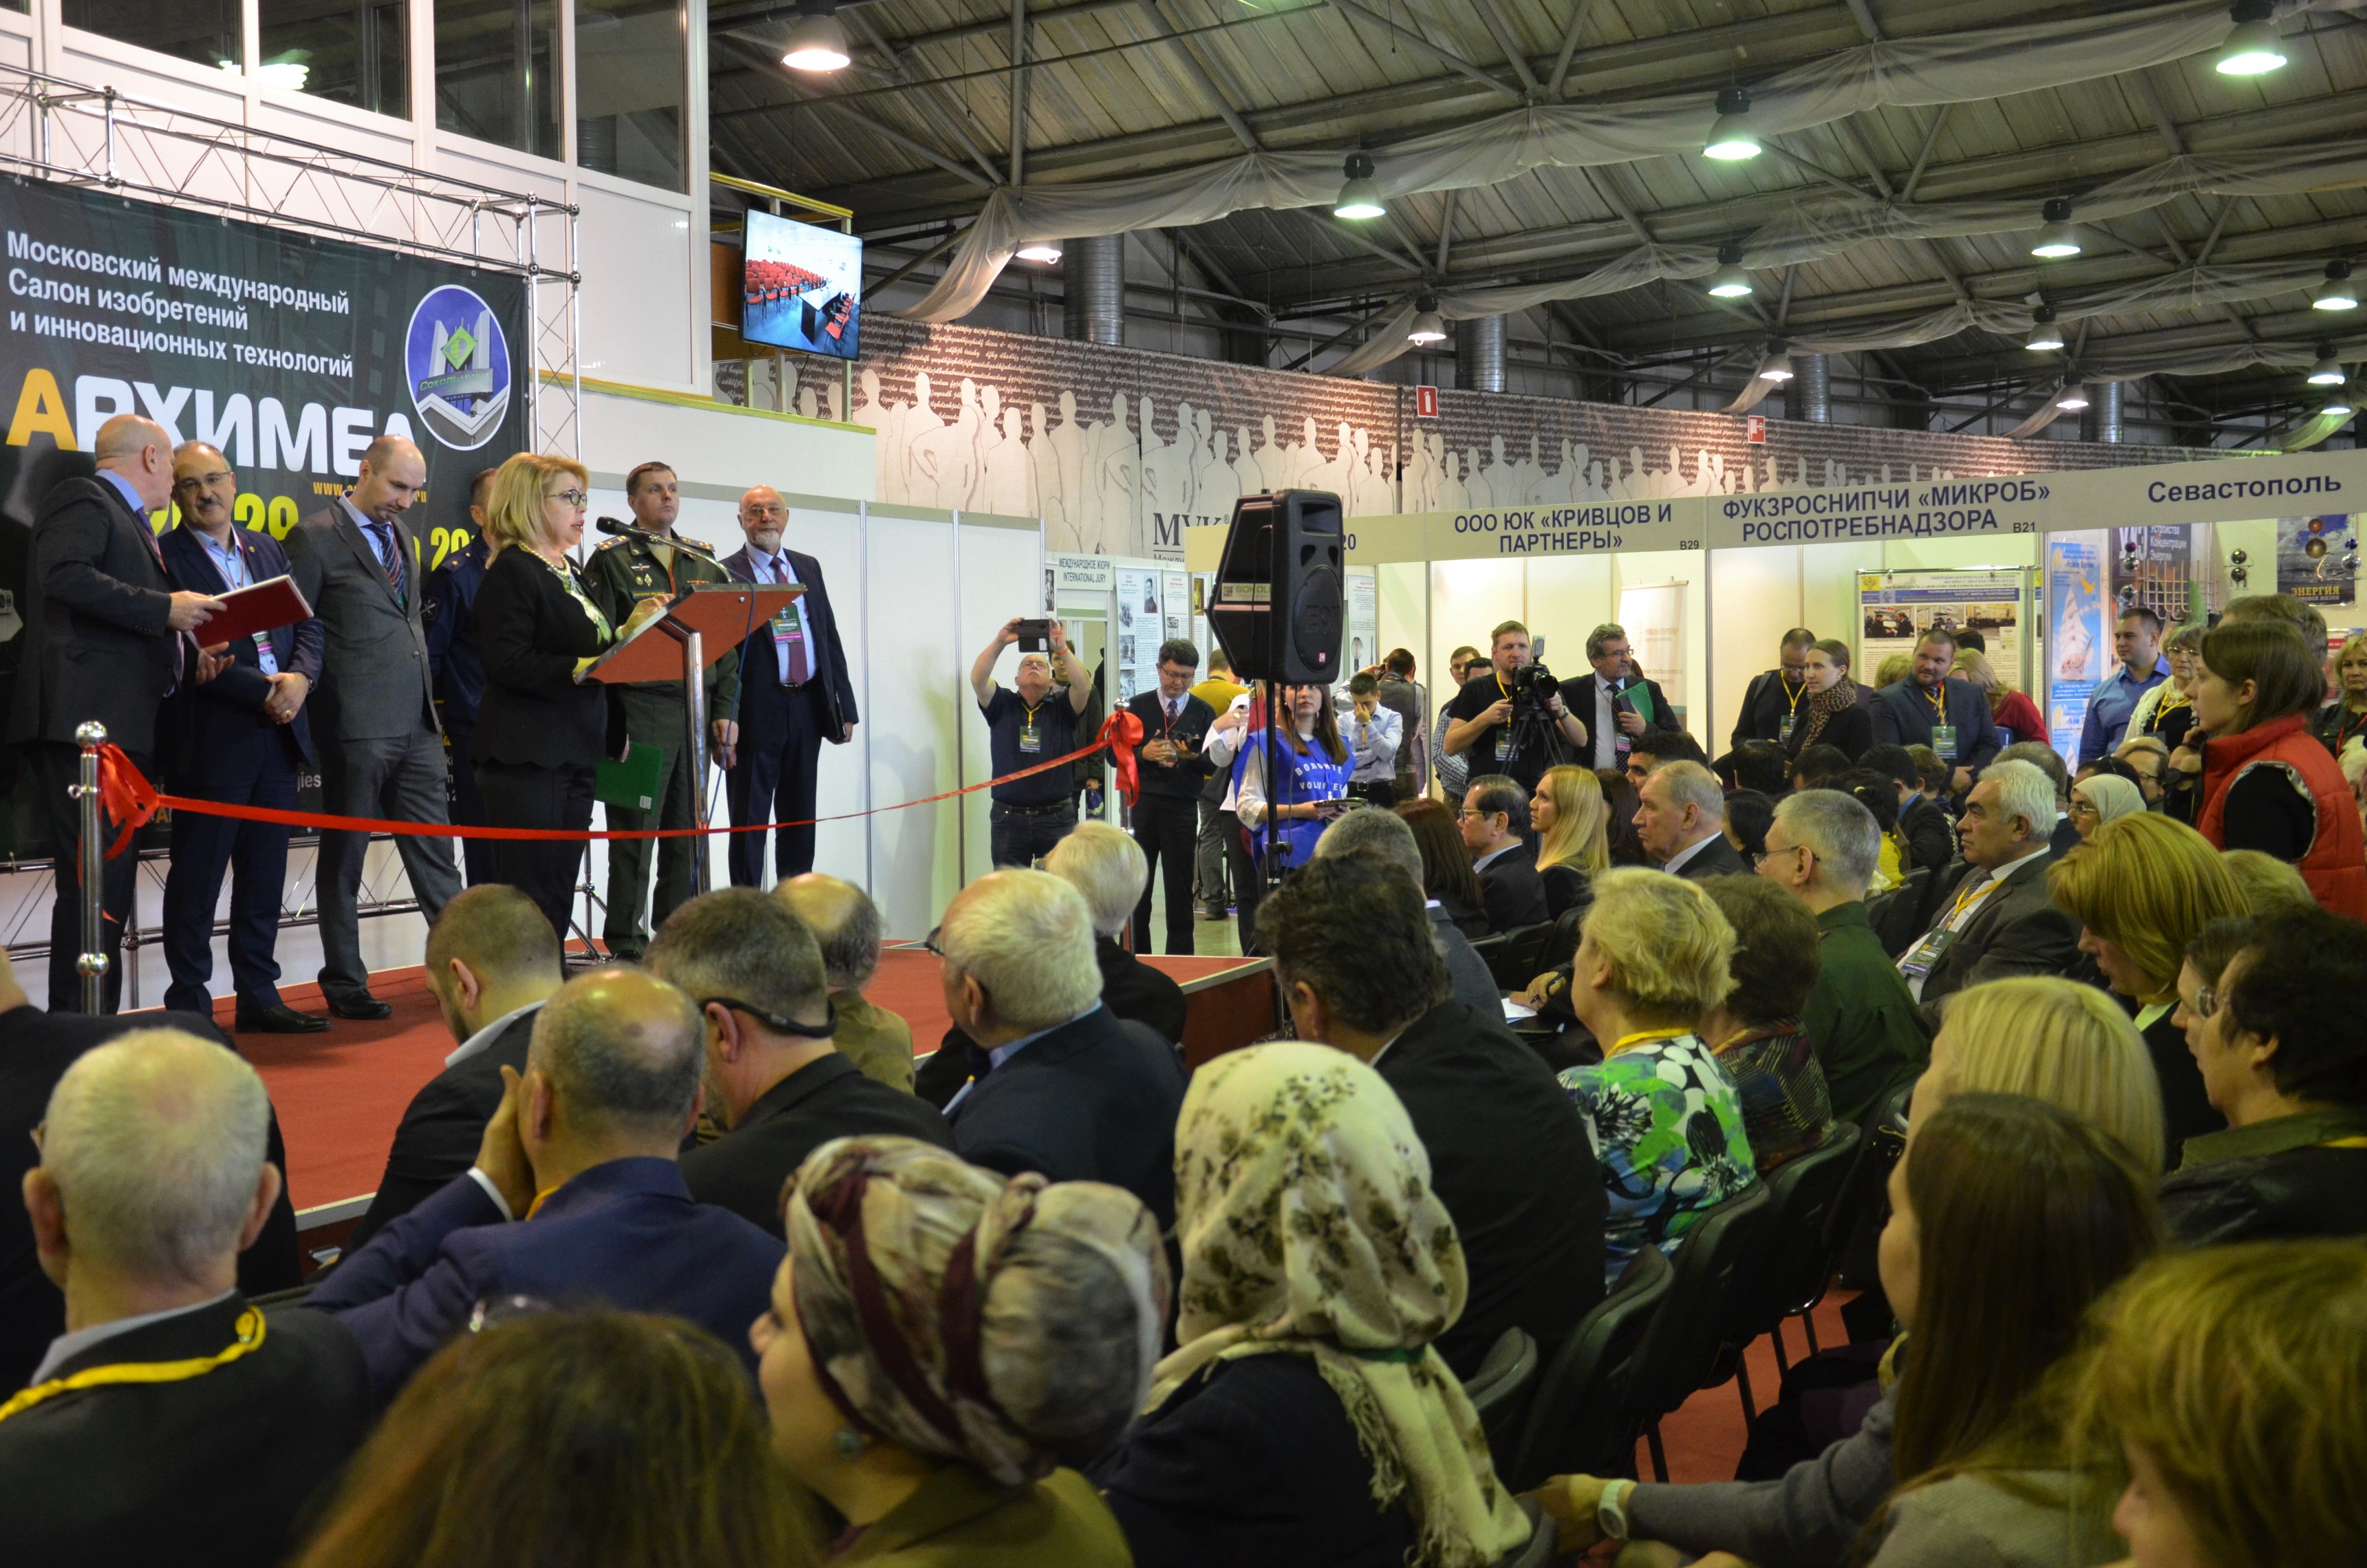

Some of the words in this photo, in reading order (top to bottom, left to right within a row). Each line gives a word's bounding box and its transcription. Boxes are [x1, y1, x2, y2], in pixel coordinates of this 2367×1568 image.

[8, 230, 162, 283] Московский
[169, 266, 349, 314] международный
[9, 268, 90, 305] Салон
[98, 290, 248, 330] изобретений
[10, 311, 26, 332] и
[34, 314, 227, 361] инновационных
[233, 343, 353, 378] технологий
[1723, 489, 1909, 519] ФУКЗРОСНИПЧИ
[1918, 480, 2050, 507] «МИКРОБ»
[2148, 476, 2342, 503] Севастополь
[1455, 514, 1497, 533] ООО
[1503, 511, 1535, 530] ЮК
[1541, 505, 1651, 528] «КРИВЦОВ
[1658, 504, 1672, 522] И
[1742, 508, 1998, 542] РОСПОТРЕБНАДЗОРА
[1499, 530, 1622, 553] ПАРТНЕРЫ»
[1059, 558, 1096, 570] МЕЖДУНАРОДНОЕ
[1097, 559, 1111, 570] ЖЮРИ
[1063, 572, 1095, 582] INTERNATIONAL
[1095, 574, 1106, 583] JURY
[2291, 586, 2340, 597] ЭНЕРГИЯ
